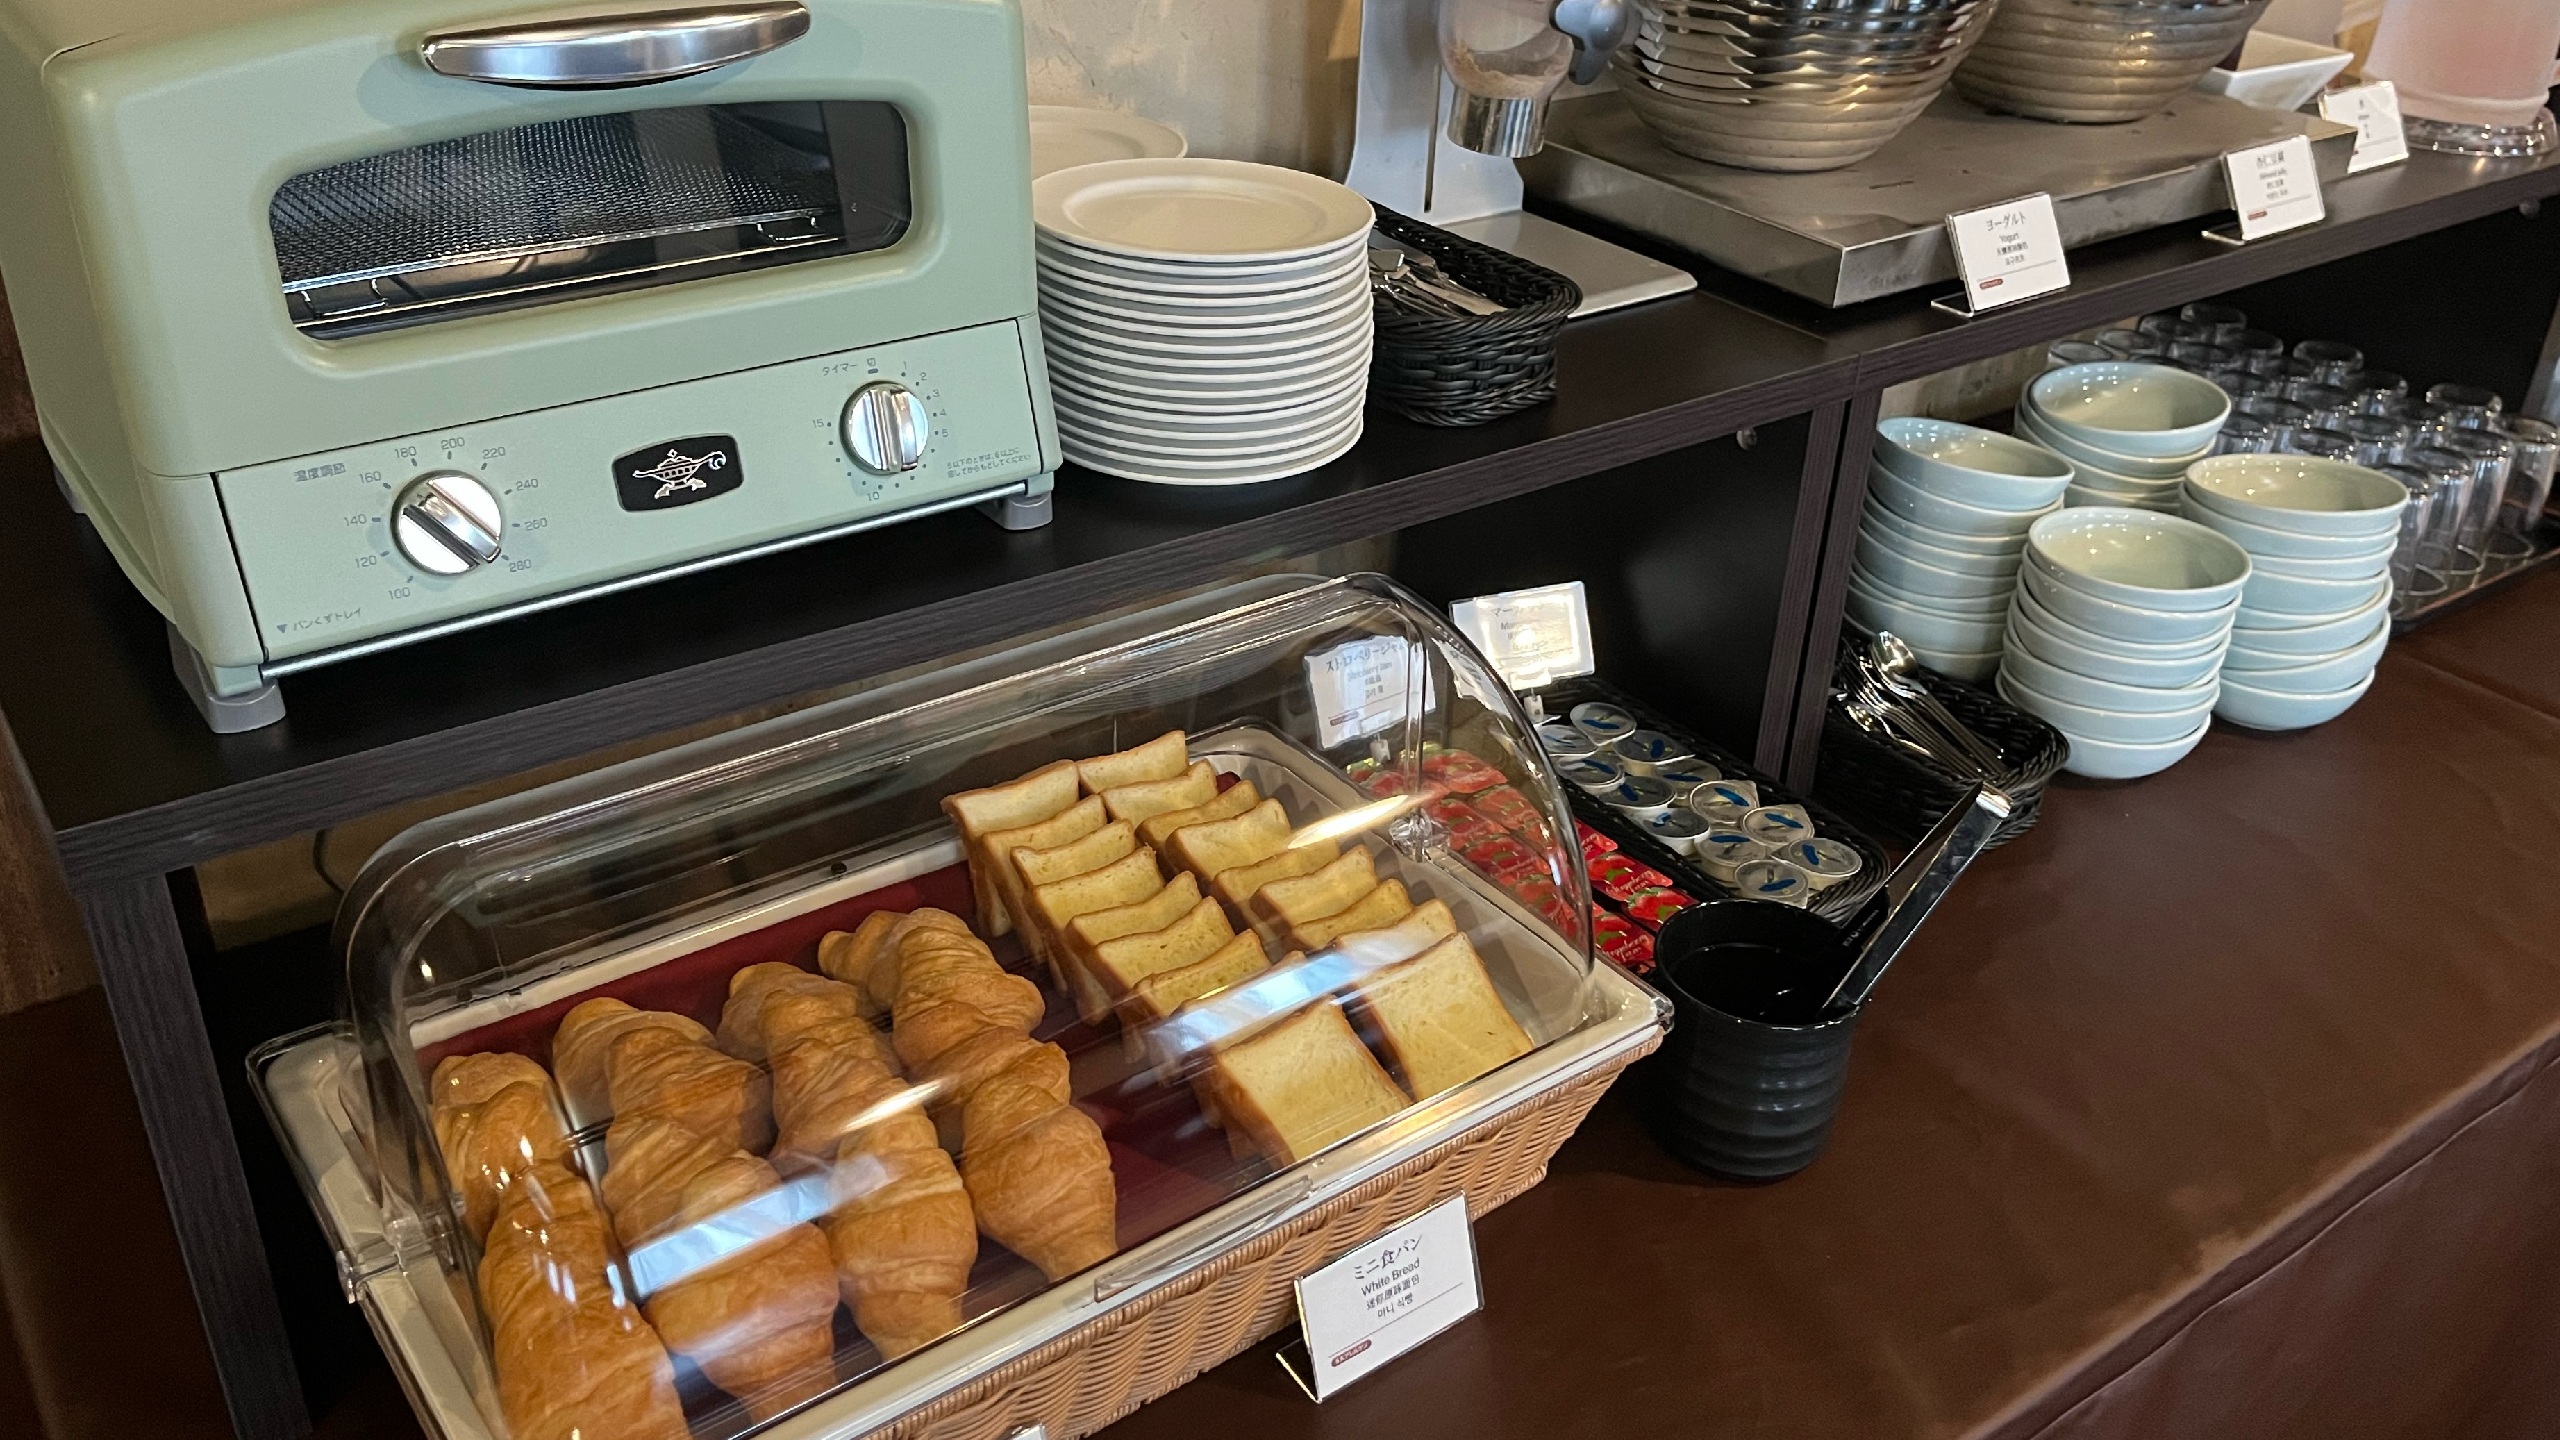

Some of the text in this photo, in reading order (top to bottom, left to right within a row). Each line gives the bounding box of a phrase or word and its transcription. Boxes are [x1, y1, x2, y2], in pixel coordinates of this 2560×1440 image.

[1985, 210, 2026, 232] ヨーグルト
[822, 363, 858, 377] タイマー
[919, 371, 928, 381] 2
[932, 388, 940, 398] 3
[939, 408, 947, 416] 4
[812, 418, 825, 429] 15
[941, 428, 949, 438] 5
[440, 436, 466, 450] 200
[394, 446, 418, 459] 180
[482, 446, 507, 460] 220
[360, 470, 382, 484] 160
[514, 478, 539, 491] 240
[866, 491, 880, 502] 10
[343, 513, 368, 527] 140
[354, 555, 378, 569] 120
[388, 586, 411, 600] 100
[293, 606, 362, 632] パンくずトレイ
[1354, 1233, 1422, 1280] ミニ食パン
[1361, 1256, 1420, 1297] White Bread
[1377, 1302, 1395, 1318] 미니
